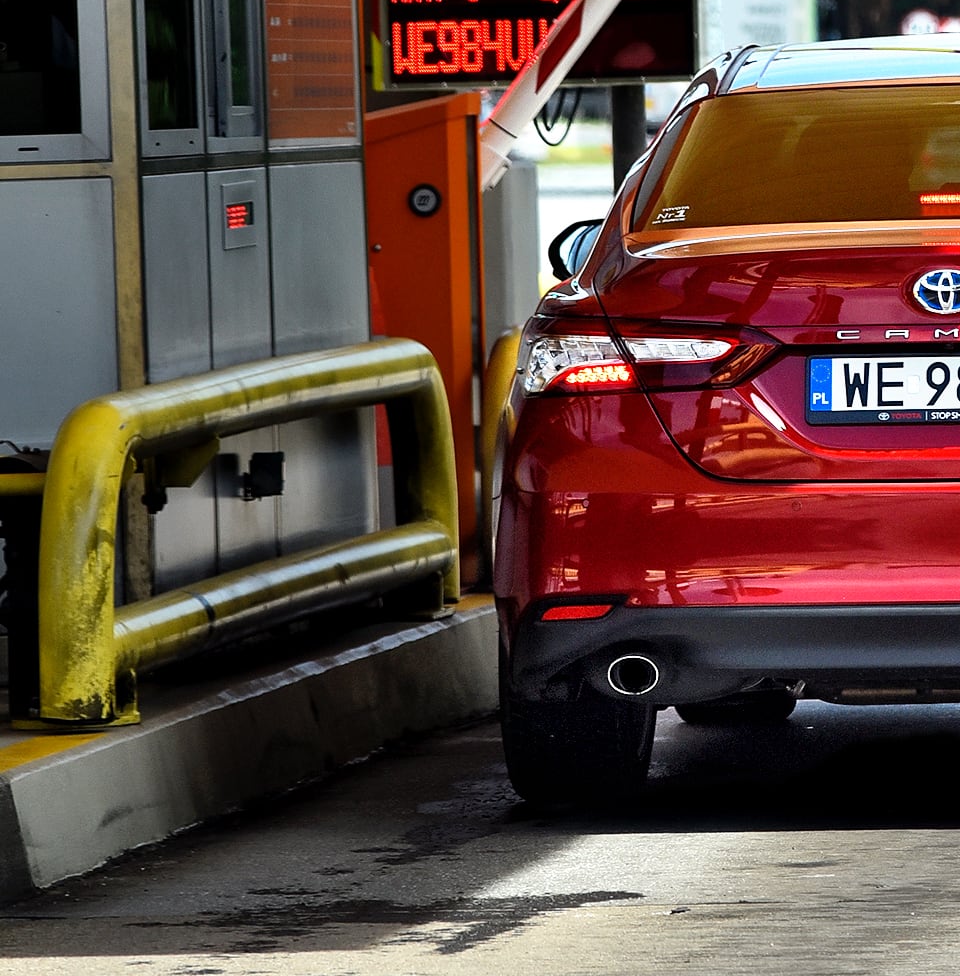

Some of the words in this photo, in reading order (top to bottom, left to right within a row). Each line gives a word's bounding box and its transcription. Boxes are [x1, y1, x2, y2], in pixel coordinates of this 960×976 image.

[391, 19, 552, 75] WE984V
[812, 392, 829, 405] PL
[843, 362, 904, 408] WE
[891, 412, 922, 421] TOYOTA
